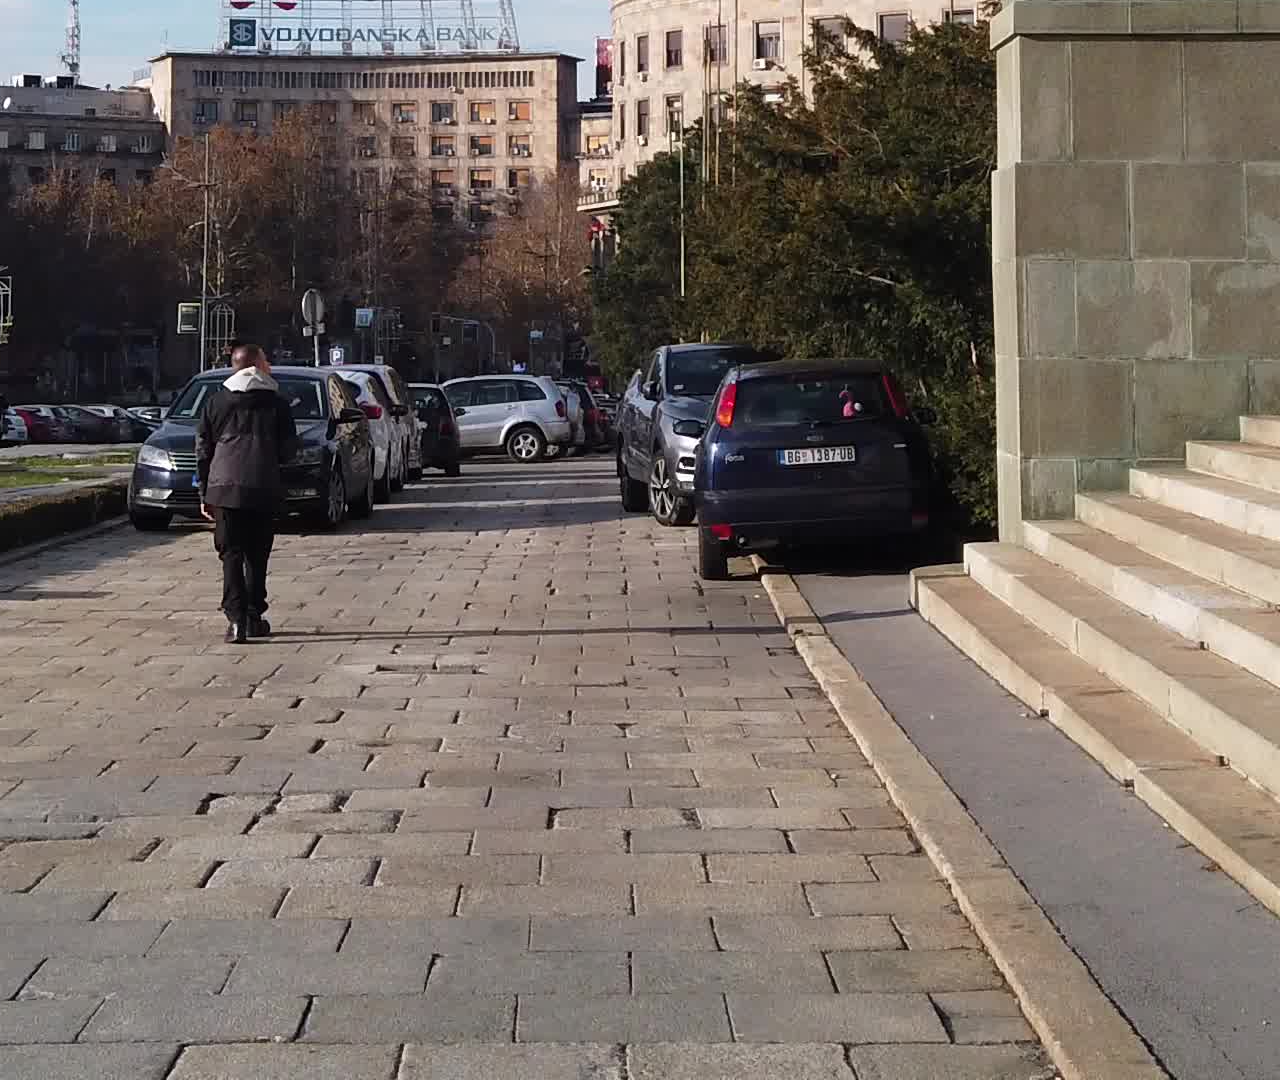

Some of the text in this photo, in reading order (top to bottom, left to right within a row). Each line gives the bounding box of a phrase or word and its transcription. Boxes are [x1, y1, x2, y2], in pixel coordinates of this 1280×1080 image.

[260, 27, 513, 42] VOJVOĐANSKA BANKA
[333, 350, 341, 361] P
[787, 450, 801, 463] BG
